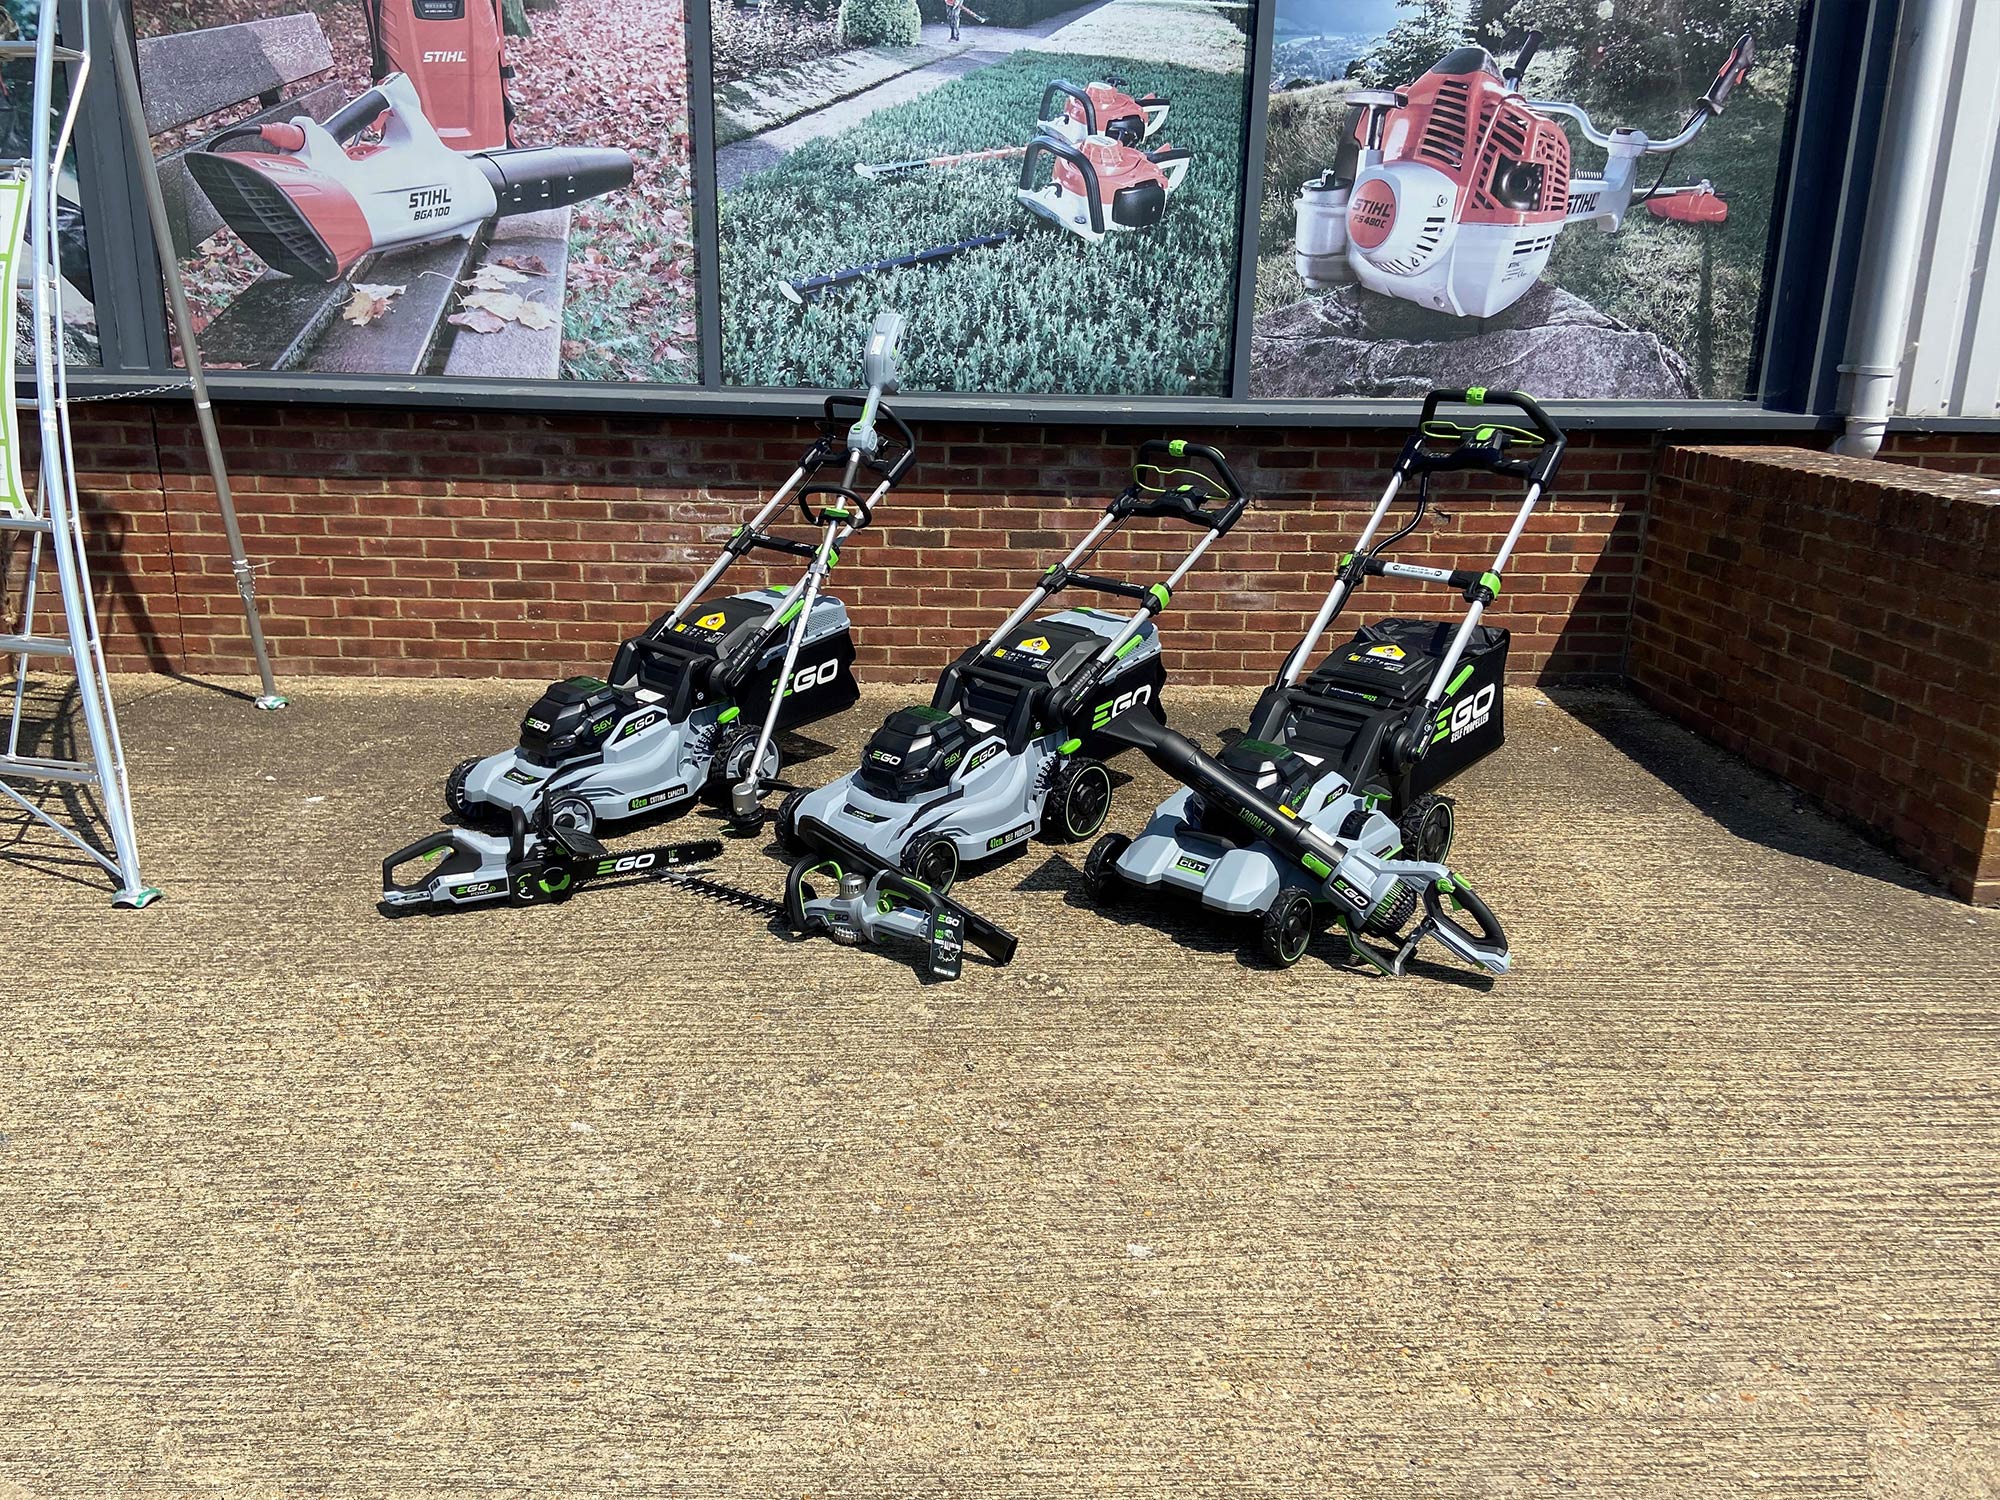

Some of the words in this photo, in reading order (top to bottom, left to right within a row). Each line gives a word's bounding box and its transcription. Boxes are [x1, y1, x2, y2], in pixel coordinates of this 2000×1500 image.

[423, 51, 467, 63] STIHL
[409, 188, 452, 208] STIHL
[1567, 192, 1599, 214] STIHL
[414, 208, 433, 221] BGA
[434, 206, 451, 218] 100
[1353, 199, 1391, 218] STIHL
[1353, 214, 1364, 223] FS
[1364, 217, 1381, 228] 490
[1380, 219, 1387, 229] C
[1091, 684, 1152, 731] EGO
[1431, 682, 1496, 745] EGO
[526, 717, 551, 732] EGO
[593, 717, 613, 734] 56V
[625, 713, 656, 736] EGO
[1450, 727, 1464, 743] SELF
[872, 750, 902, 766] EGO
[944, 749, 961, 767] 56V
[971, 745, 997, 769] EGO
[631, 798, 648, 809] 42cm
[597, 853, 656, 875] EGO
[1179, 859, 1206, 871] CUT
[456, 882, 490, 895] EGO
[1333, 879, 1369, 907] EGO
[827, 912, 850, 922] EGO
[937, 914, 960, 927] EGO
